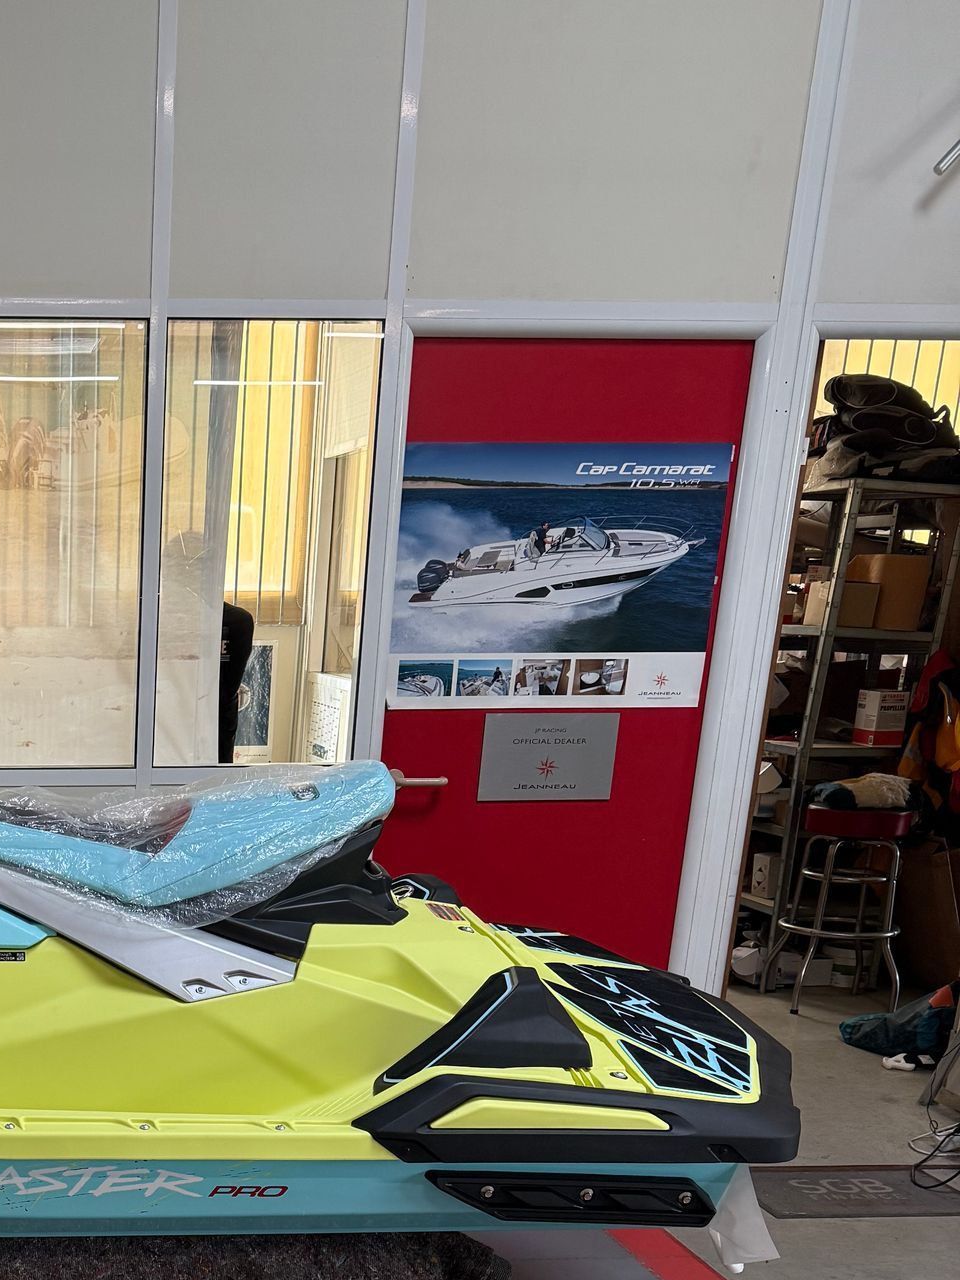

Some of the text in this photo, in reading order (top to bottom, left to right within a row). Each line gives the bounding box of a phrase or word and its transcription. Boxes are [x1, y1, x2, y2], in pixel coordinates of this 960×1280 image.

[575, 462, 716, 475] Cap Camarat
[629, 478, 676, 489] 10.5
[208, 1184, 289, 1198] PRO
[788, 1178, 894, 1194] SGB
